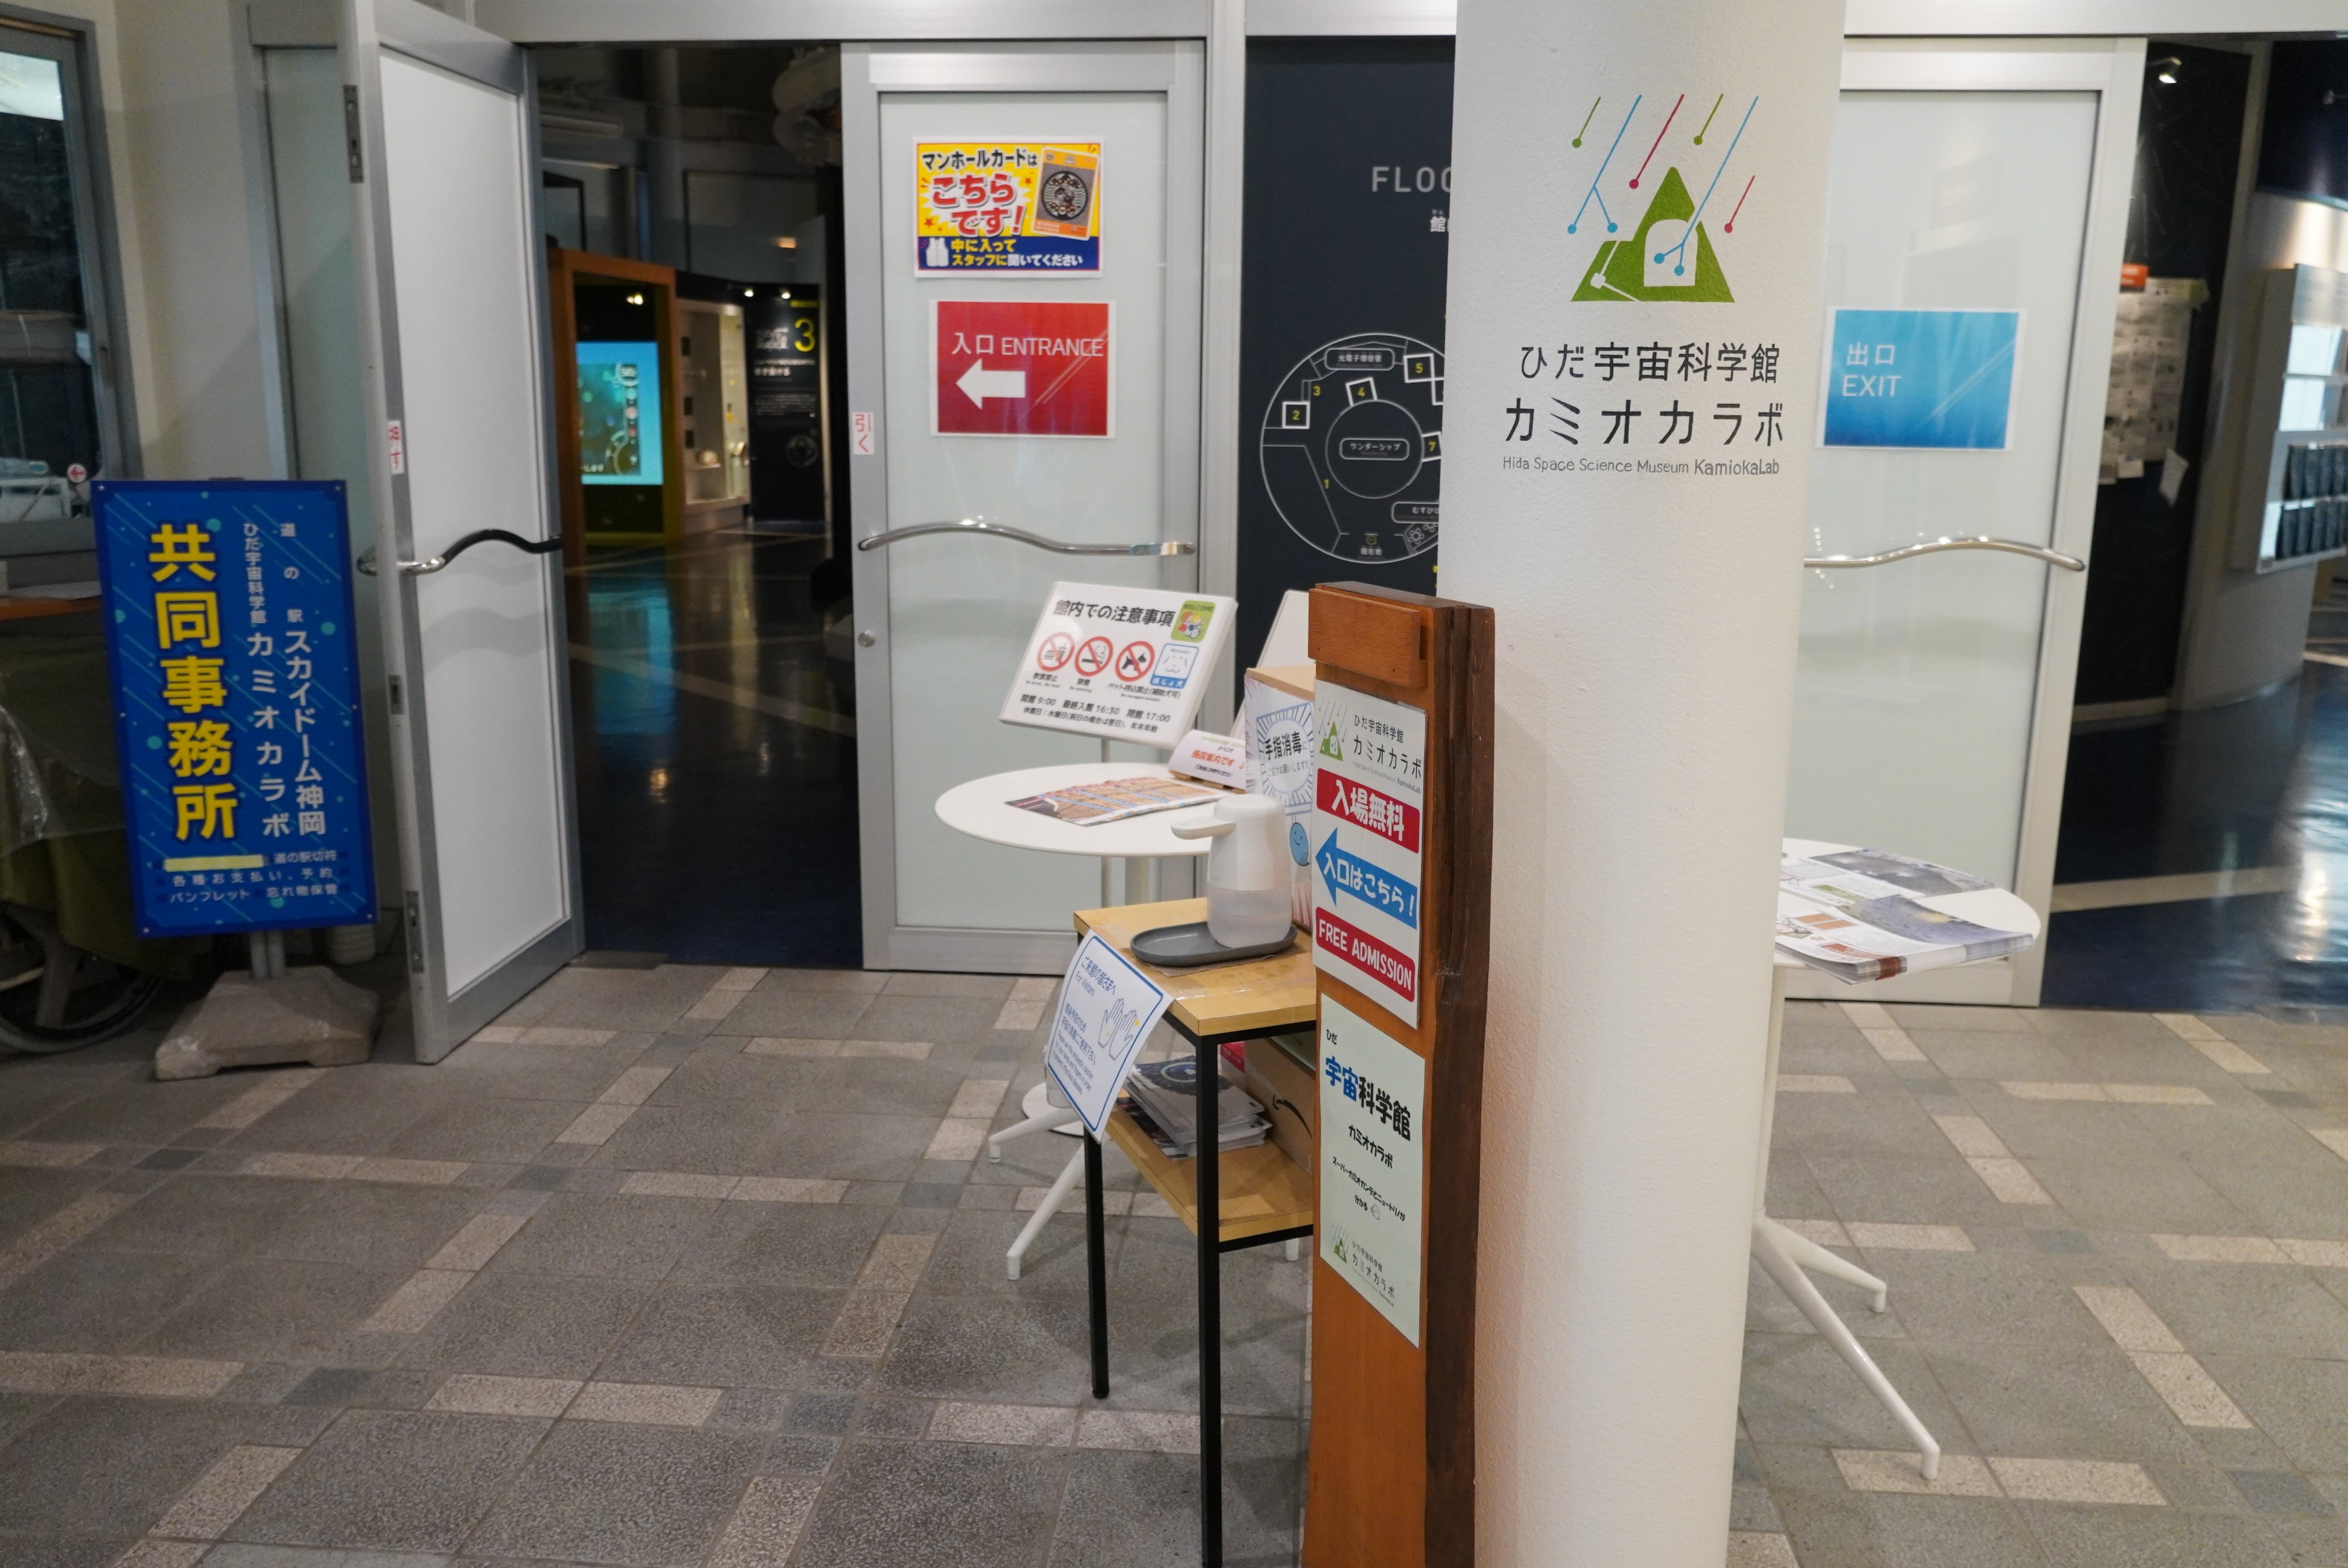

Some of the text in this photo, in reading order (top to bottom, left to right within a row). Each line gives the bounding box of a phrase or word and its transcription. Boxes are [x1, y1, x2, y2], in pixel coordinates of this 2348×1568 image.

[922, 149, 1038, 170] マンホールカードは
[932, 173, 1015, 205] こちら
[951, 205, 1025, 235] です！
[1429, 216, 1449, 233] 館
[951, 239, 1017, 252] 中に入って
[952, 254, 1084, 267] スタッフに聞いてください
[794, 318, 815, 352] 3
[952, 332, 1104, 357] 入口 ENTRANCE
[1521, 341, 1779, 383] ひだ宇宙科学館
[1846, 342, 1896, 366] 出口
[1415, 363, 1423, 374] 5
[1313, 386, 1321, 397] 3
[1357, 386, 1366, 397] 4
[1842, 374, 1902, 397] EXIT
[1292, 410, 1300, 421] 2
[1505, 397, 1784, 447] カミオカラボ
[855, 414, 872, 453] 引く
[1350, 442, 1400, 451] ワンダーシップ
[1428, 441, 1436, 452] 7
[1503, 456, 1779, 476] Hida Space Science Museum KamiokaLab
[1324, 478, 1329, 488] 1
[1053, 599, 1176, 627] 館内での注意事項
[1184, 603, 1214, 612] WELCOME
[148, 523, 238, 841] 共同事務所
[243, 522, 291, 838] ひだ宇宙科学館 カミオカラボ
[280, 522, 326, 836] 道の駅 スカイドーム神岡
[1152, 677, 1184, 688] ほじょ犬
[1037, 697, 1056, 706] 9:00
[1096, 705, 1120, 715] 16:30
[1146, 712, 1171, 723] 17:00
[1354, 715, 1403, 744] ひだ宇宙科学館
[1265, 730, 1307, 760] 手指消毒に
[1353, 734, 1422, 779] カミオカラボ
[1396, 777, 1421, 794] KamiokaLab
[1331, 779, 1404, 842] 入場無料
[170, 889, 251, 903] パンフレット
[1324, 852, 1415, 917] 入口はこちら！
[1318, 918, 1411, 992] FREE ADMISSION
[1081, 956, 1116, 996] ご来館の皆さまへ
[1082, 977, 1095, 996] Visitors
[1326, 1028, 1338, 1045] ひだ
[1325, 1055, 1411, 1142] 宇宙科学館
[1348, 1124, 1393, 1169] カミオカラボ
[1355, 1194, 1368, 1211] 分かる
[1352, 1253, 1395, 1299] カミオカラボ
